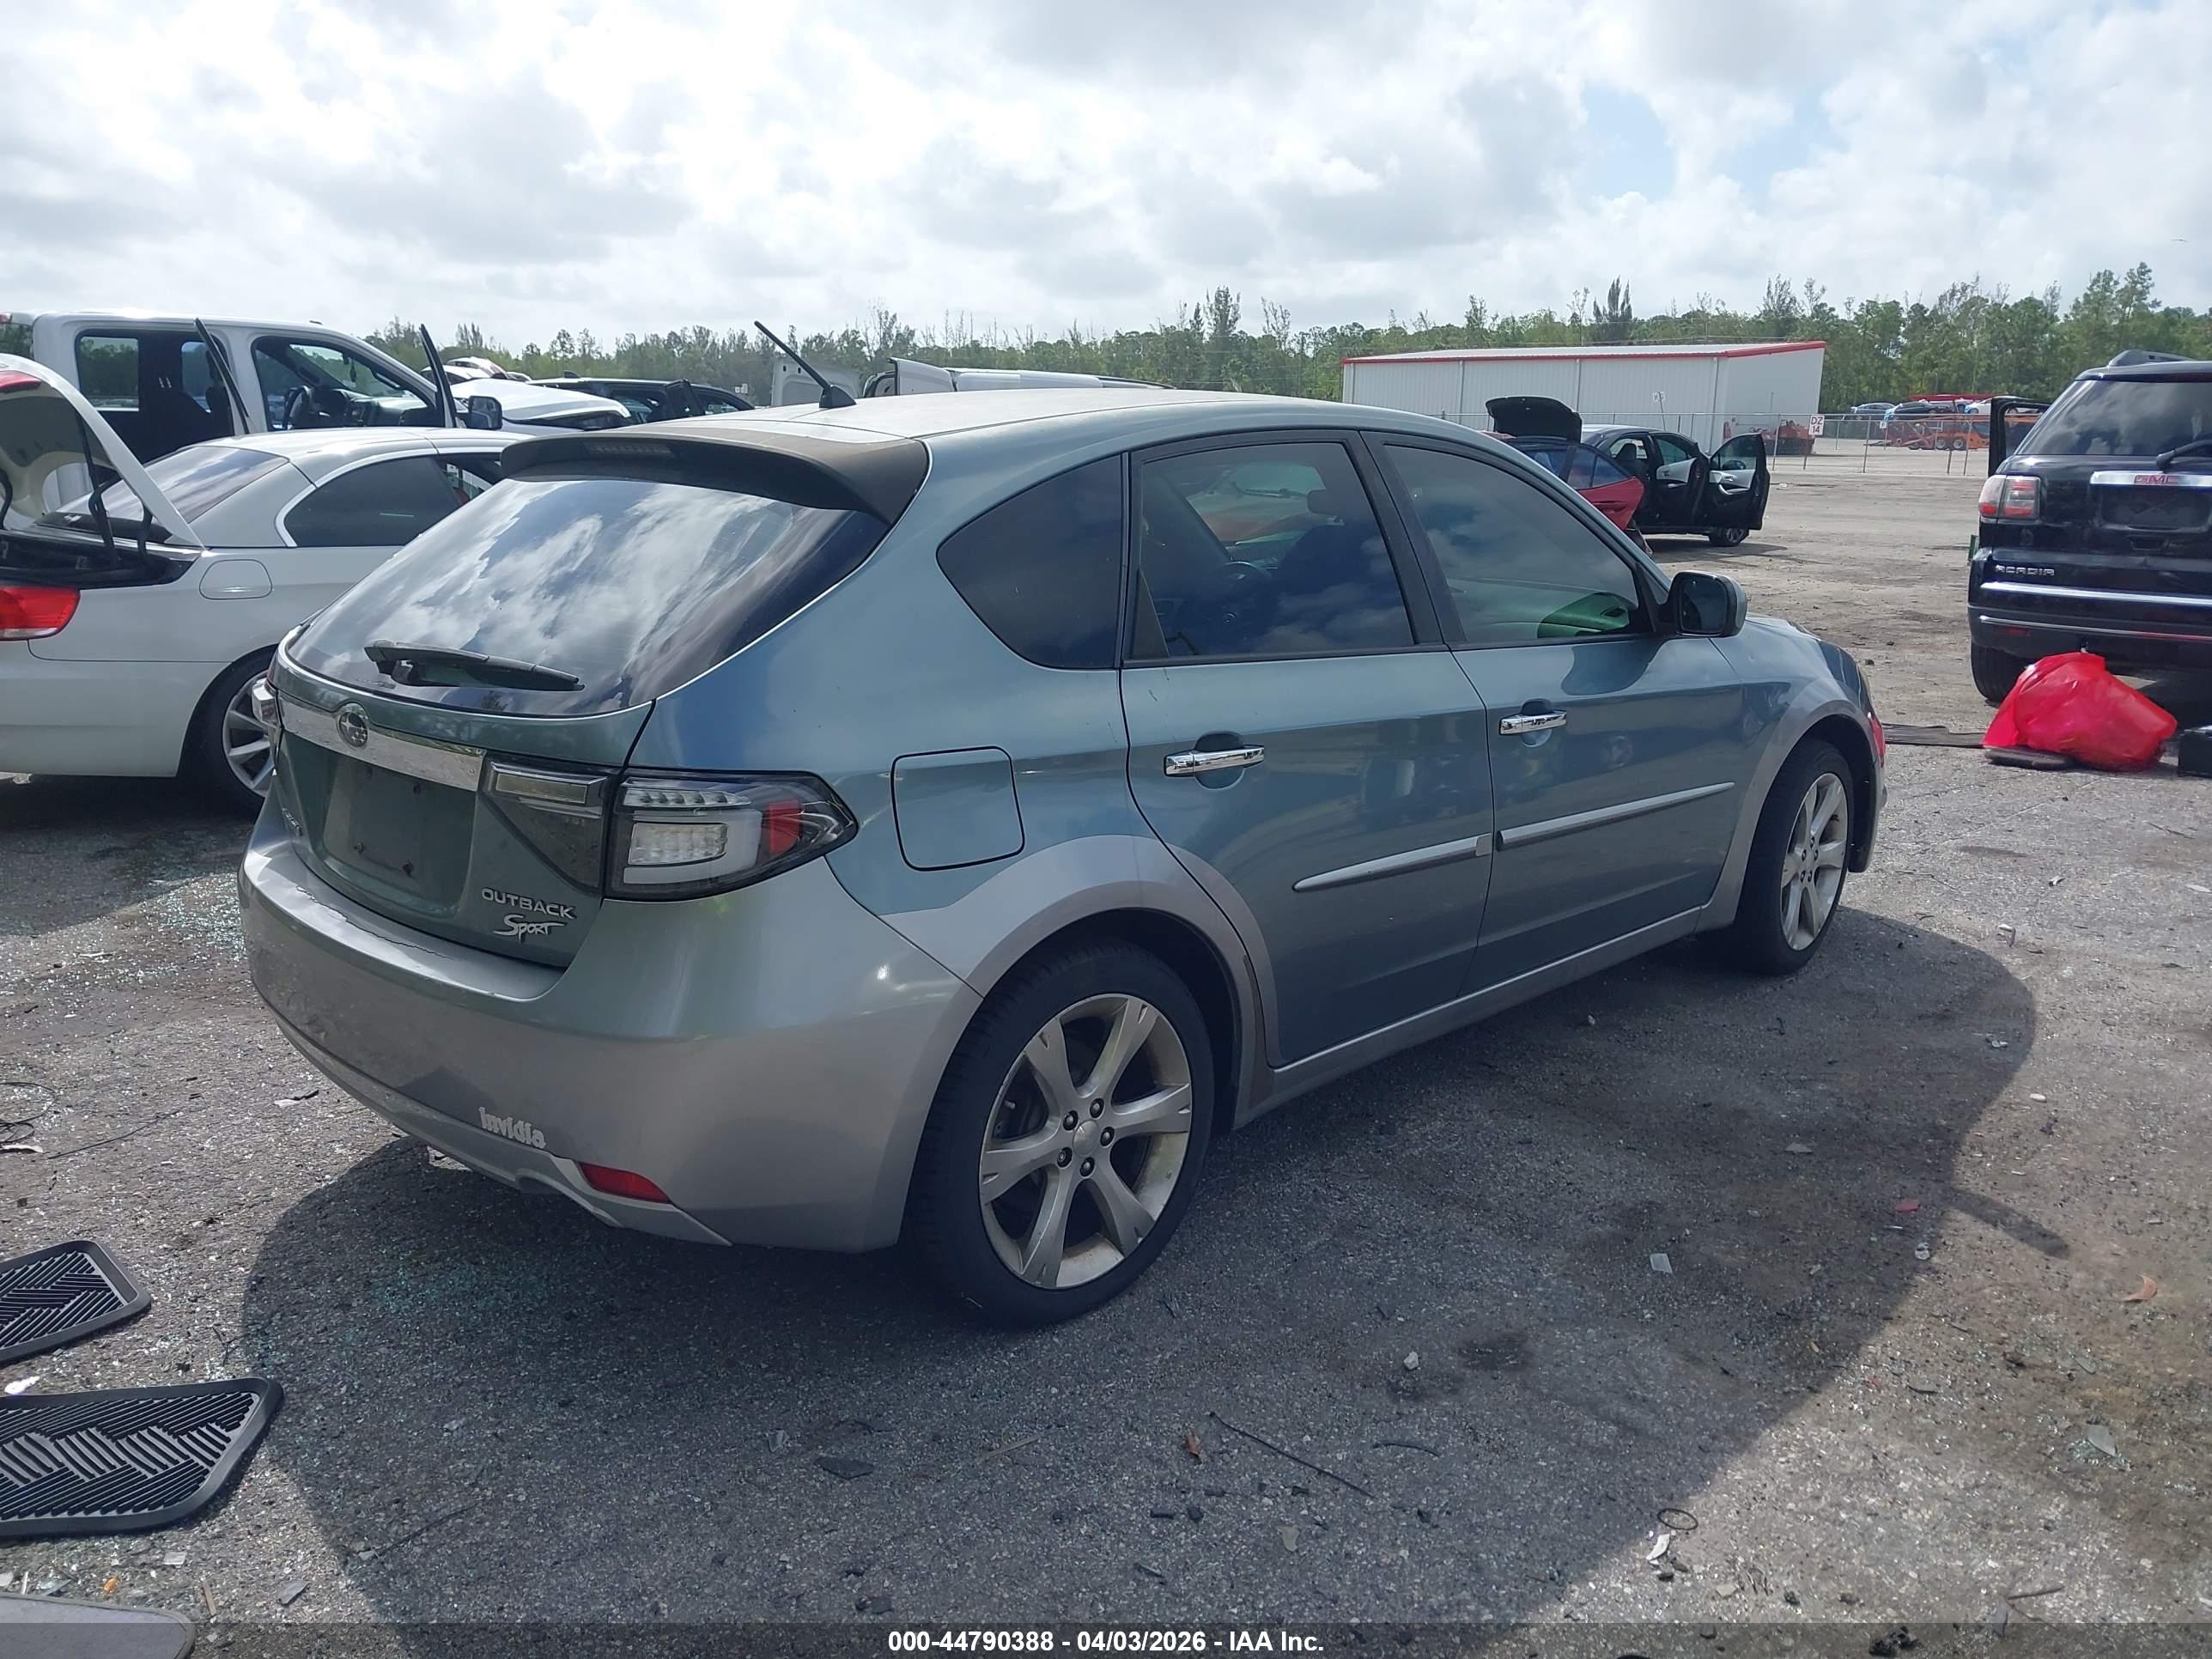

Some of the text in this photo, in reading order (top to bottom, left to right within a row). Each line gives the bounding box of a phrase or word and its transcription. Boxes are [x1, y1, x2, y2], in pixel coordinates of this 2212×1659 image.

[1811, 416, 1823, 425] DZ
[2134, 474, 2179, 485] GMC
[1995, 564, 2055, 576] ACADIA
[481, 887, 578, 920] OUTBACK
